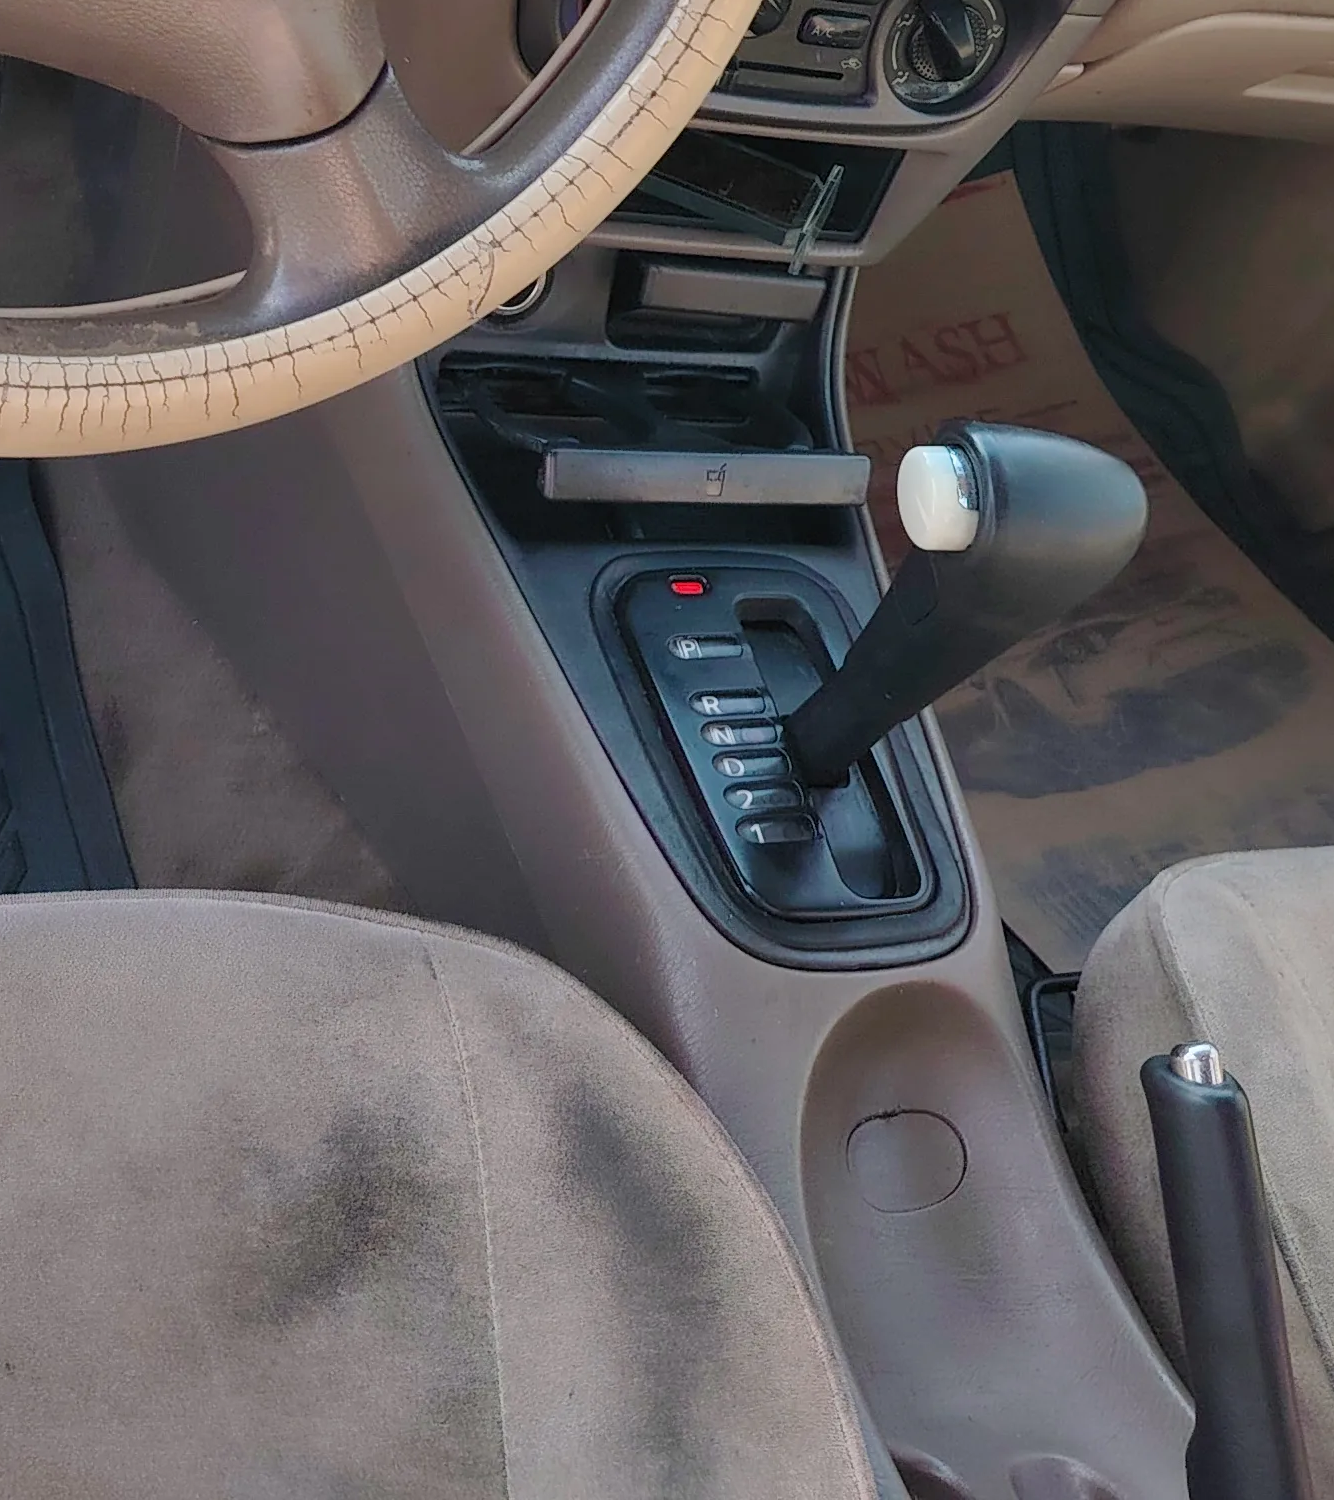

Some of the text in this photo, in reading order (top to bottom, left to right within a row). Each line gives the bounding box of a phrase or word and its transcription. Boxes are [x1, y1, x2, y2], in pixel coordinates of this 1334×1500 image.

[810, 26, 836, 39] A/C
[701, 695, 719, 714] R
[712, 726, 734, 743] N
[722, 758, 745, 776] D
[735, 789, 754, 809] 2
[750, 824, 765, 844] 1
